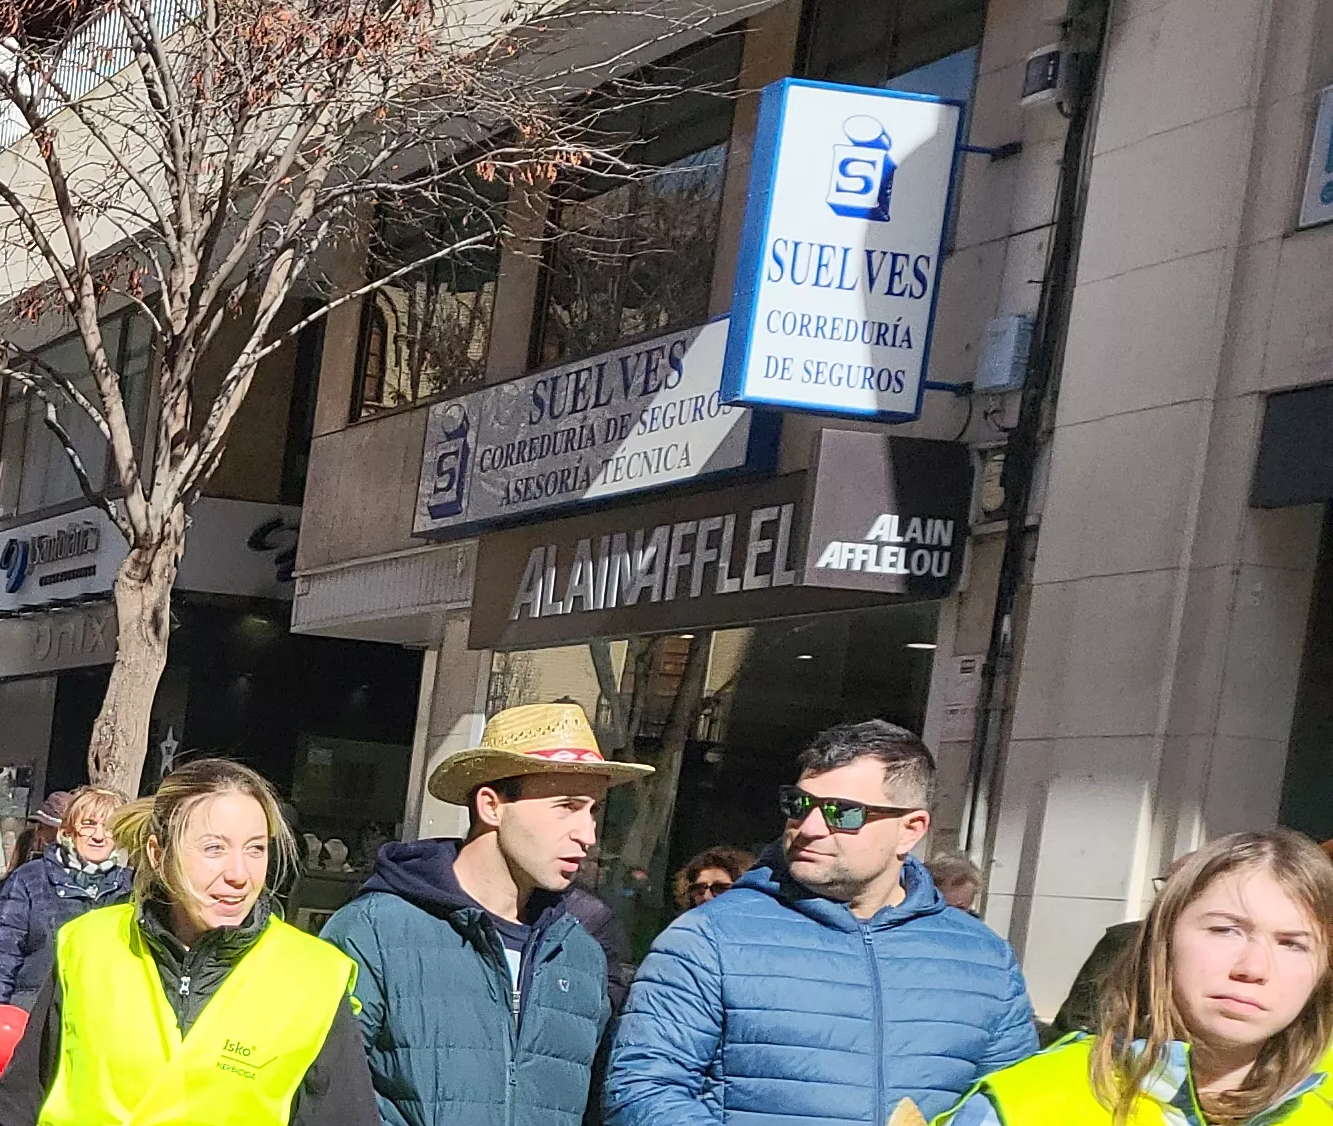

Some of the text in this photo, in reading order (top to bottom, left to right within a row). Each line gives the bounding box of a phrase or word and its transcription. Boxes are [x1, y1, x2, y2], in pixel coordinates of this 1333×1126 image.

[766, 237, 931, 300] SUELVES
[766, 309, 914, 350] CORREDURÍA
[529, 338, 688, 426] SUELVES
[764, 354, 907, 394] DE SEGUROS
[479, 421, 597, 474] CORREDURÍA
[603, 412, 631, 445] DE
[499, 440, 692, 507] ASESORÍA TÉCNICA
[816, 541, 951, 579] AFFLELOU
[866, 513, 953, 547] ALAIN
[508, 502, 797, 621] ALAIN AFFLEL
